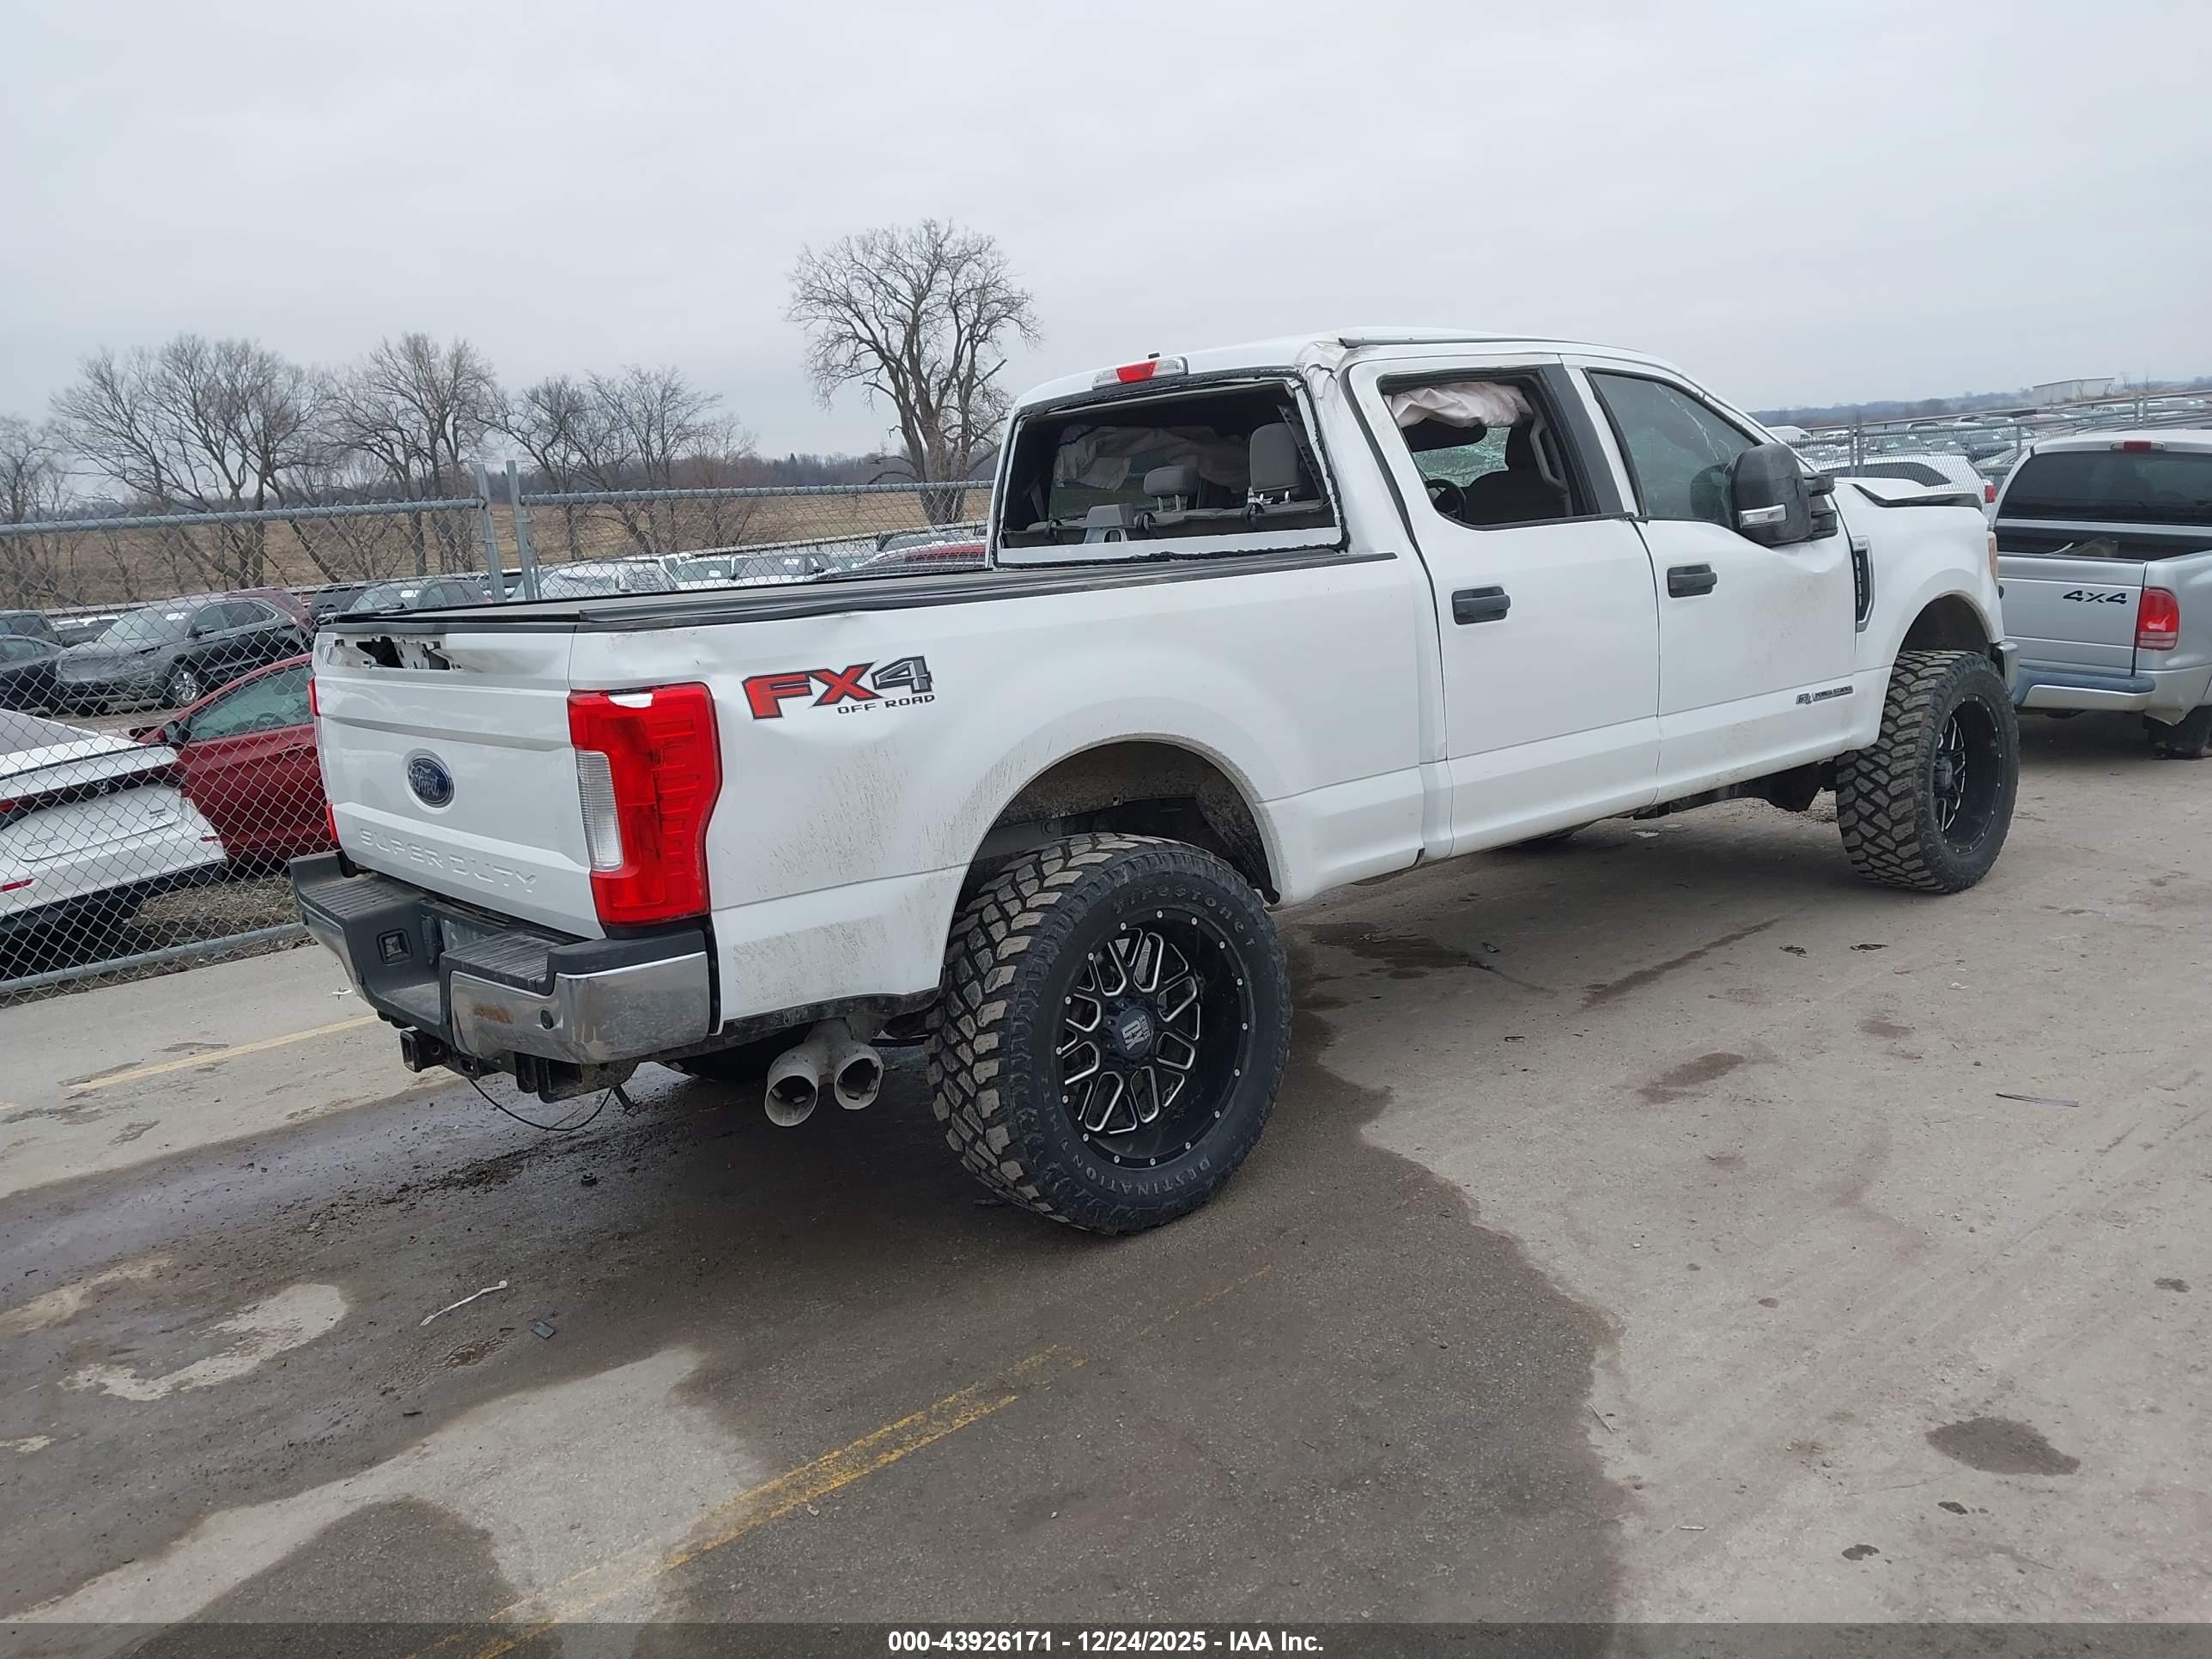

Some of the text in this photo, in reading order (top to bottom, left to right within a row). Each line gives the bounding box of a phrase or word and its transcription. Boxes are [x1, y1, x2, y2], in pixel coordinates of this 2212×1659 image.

[741, 655, 933, 720] FX4
[837, 694, 935, 714] OFF ROAD
[408, 764, 441, 797] Ford
[359, 828, 537, 894] SUPER DUTY
[1070, 1152, 1212, 1197] DESTINATION
